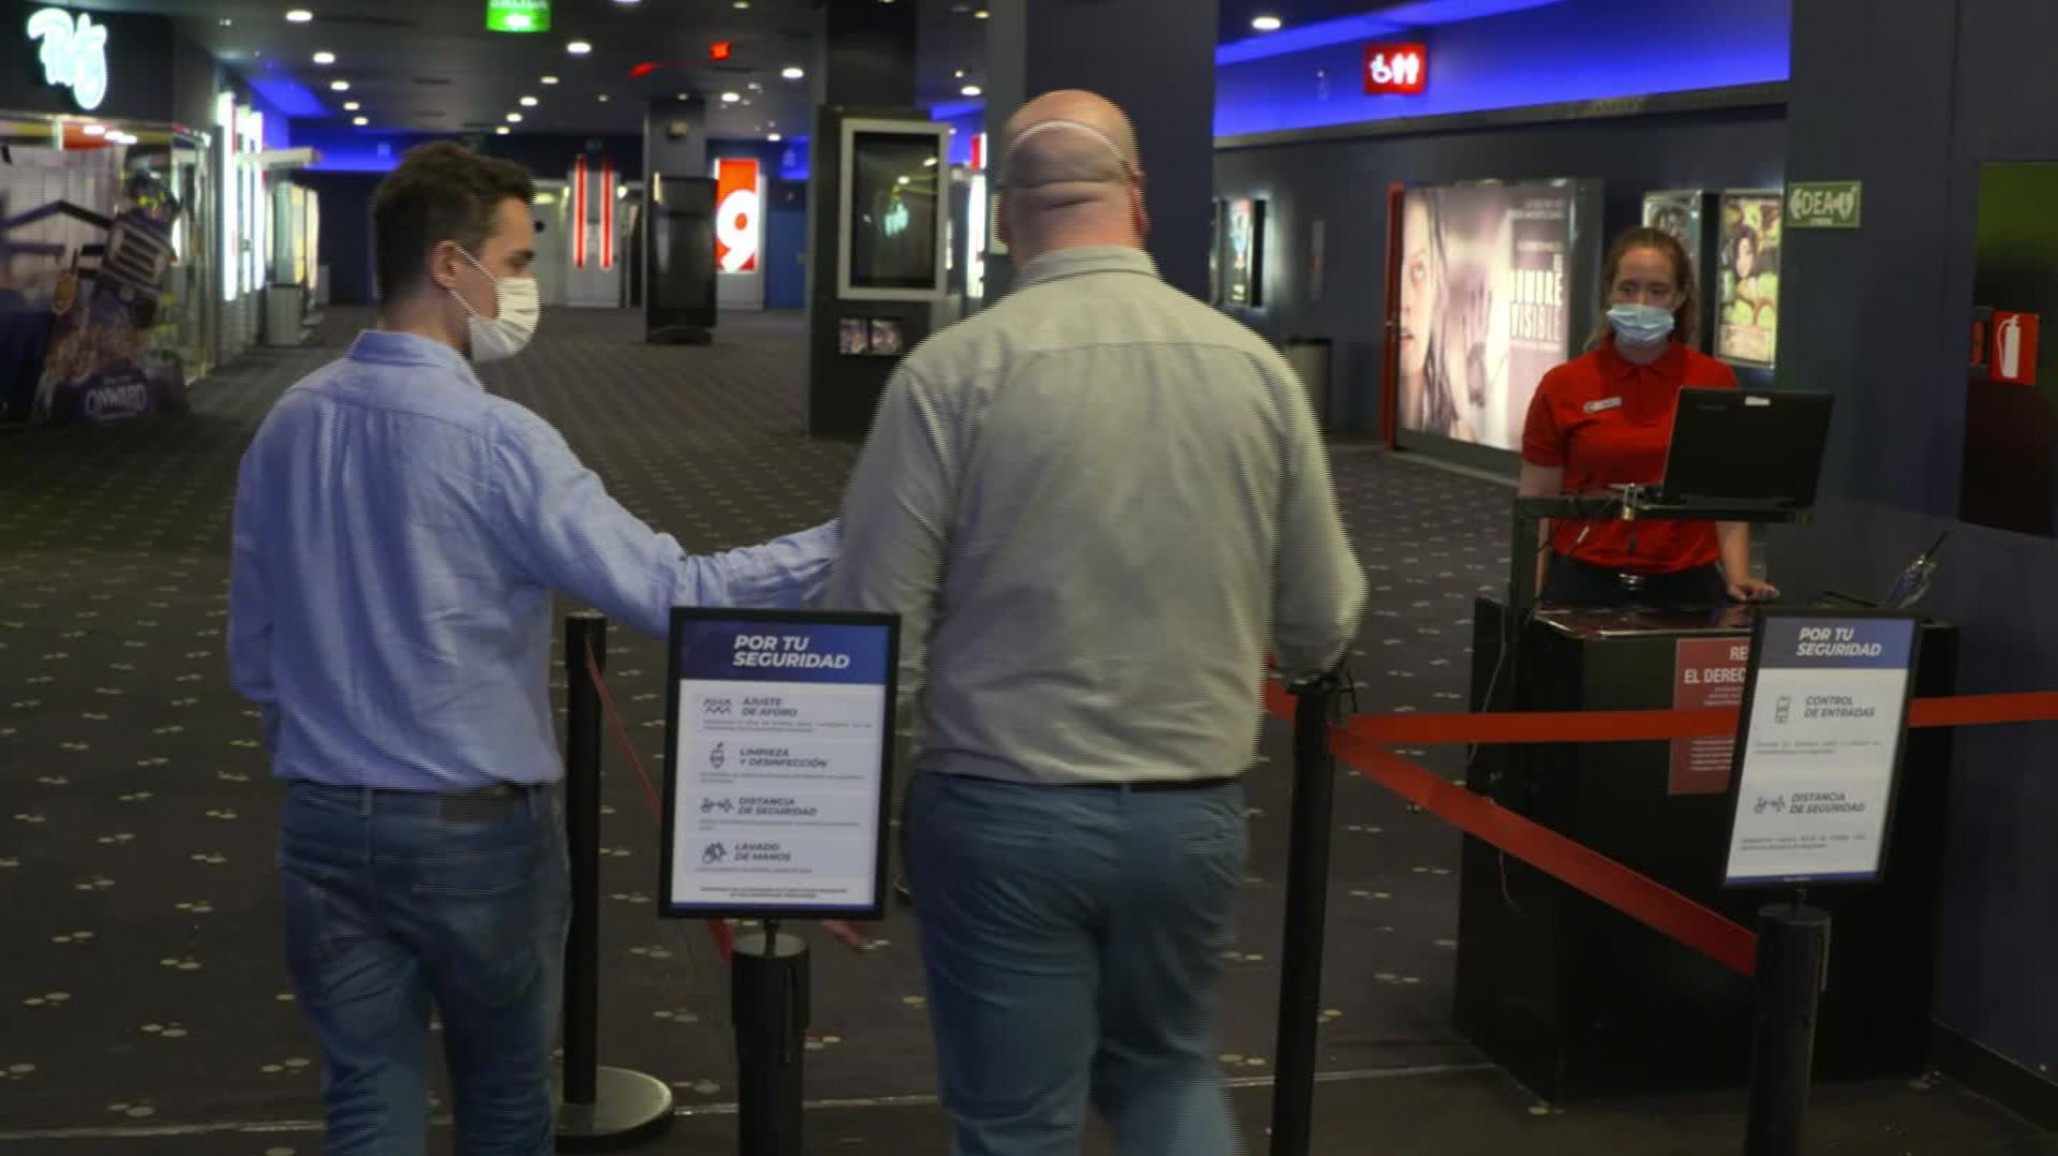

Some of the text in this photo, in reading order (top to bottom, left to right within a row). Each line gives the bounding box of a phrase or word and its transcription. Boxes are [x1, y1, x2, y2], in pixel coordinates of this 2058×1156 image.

[1801, 191, 1834, 215] DEA
[1798, 627, 1854, 641] POR TU
[733, 635, 810, 651] POR TU
[1796, 642, 1882, 657] SEGURIDAD
[732, 651, 850, 669] SEGURIDAD
[1684, 669, 1701, 684] EL
[742, 697, 782, 707] AJUSTE
[1805, 695, 1853, 706] CONTROL
[742, 707, 798, 717] DE AFORO
[1804, 706, 1876, 718] DE ENTRADAS
[739, 747, 790, 758] LIMPIEZA
[749, 757, 828, 769] DESINFECCIÓN
[738, 797, 795, 807] DISTANCIA
[1790, 792, 1846, 803] DISTANCIA
[737, 806, 818, 817] DE SEGURIDAD
[1788, 803, 1866, 815] DE SEGURIDAD
[734, 842, 780, 852] LAVADO
[733, 852, 791, 863] DE MANOS
